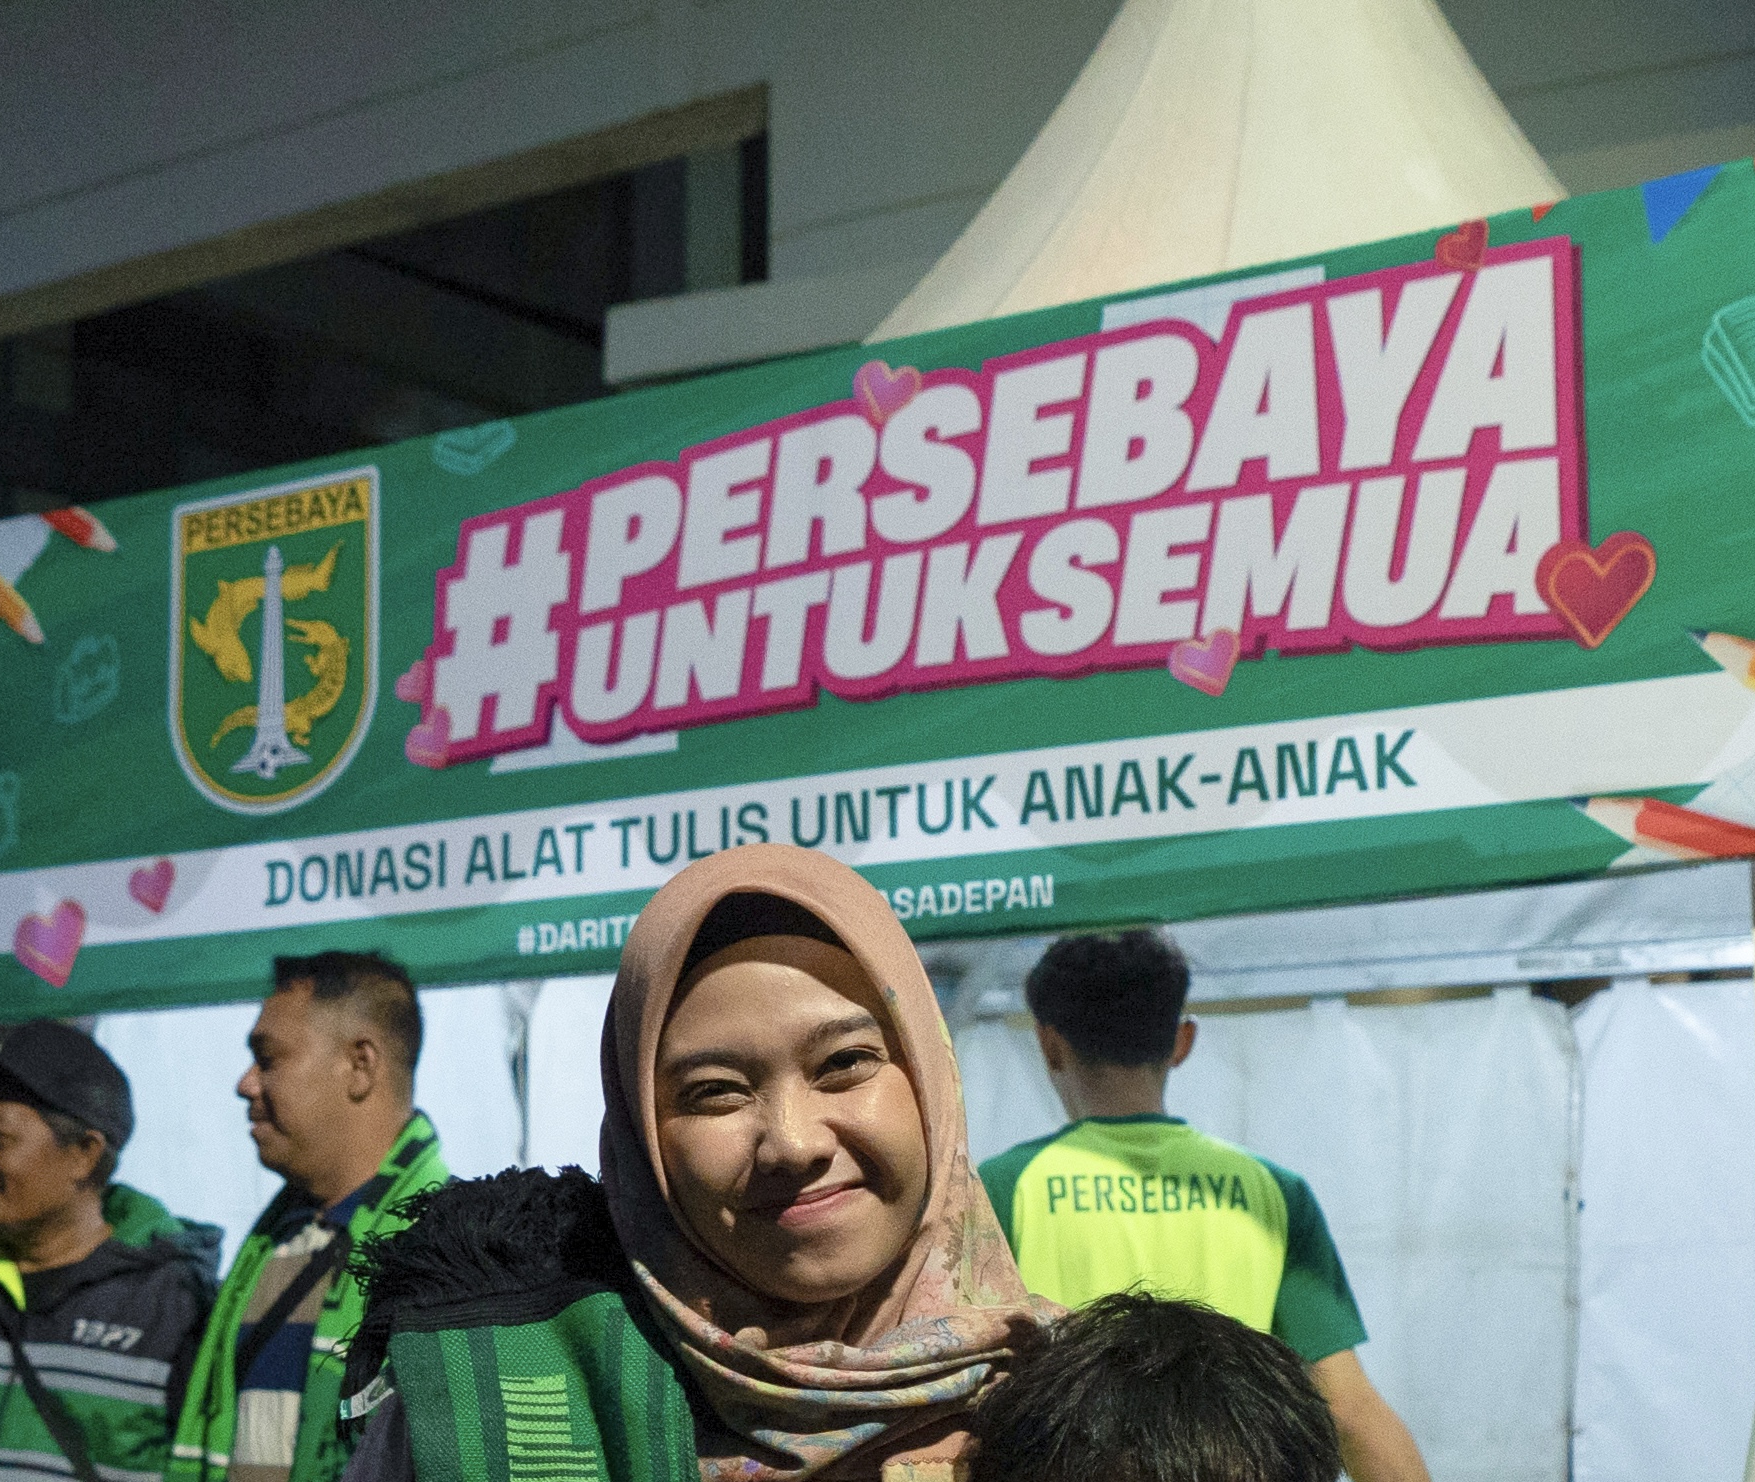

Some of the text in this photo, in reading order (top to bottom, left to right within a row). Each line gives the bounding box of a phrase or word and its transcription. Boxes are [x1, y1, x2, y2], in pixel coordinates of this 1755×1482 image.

[185, 484, 363, 547] PERSEBAYA
[442, 253, 1562, 744] #PERSEBAYA
[569, 457, 1561, 727] UNTUKSEMUA
[263, 729, 1418, 908] DONASI ALAT TULIS UNTUK ANAK-ANAK
[1046, 1173, 1249, 1214] PERSEBAYA
